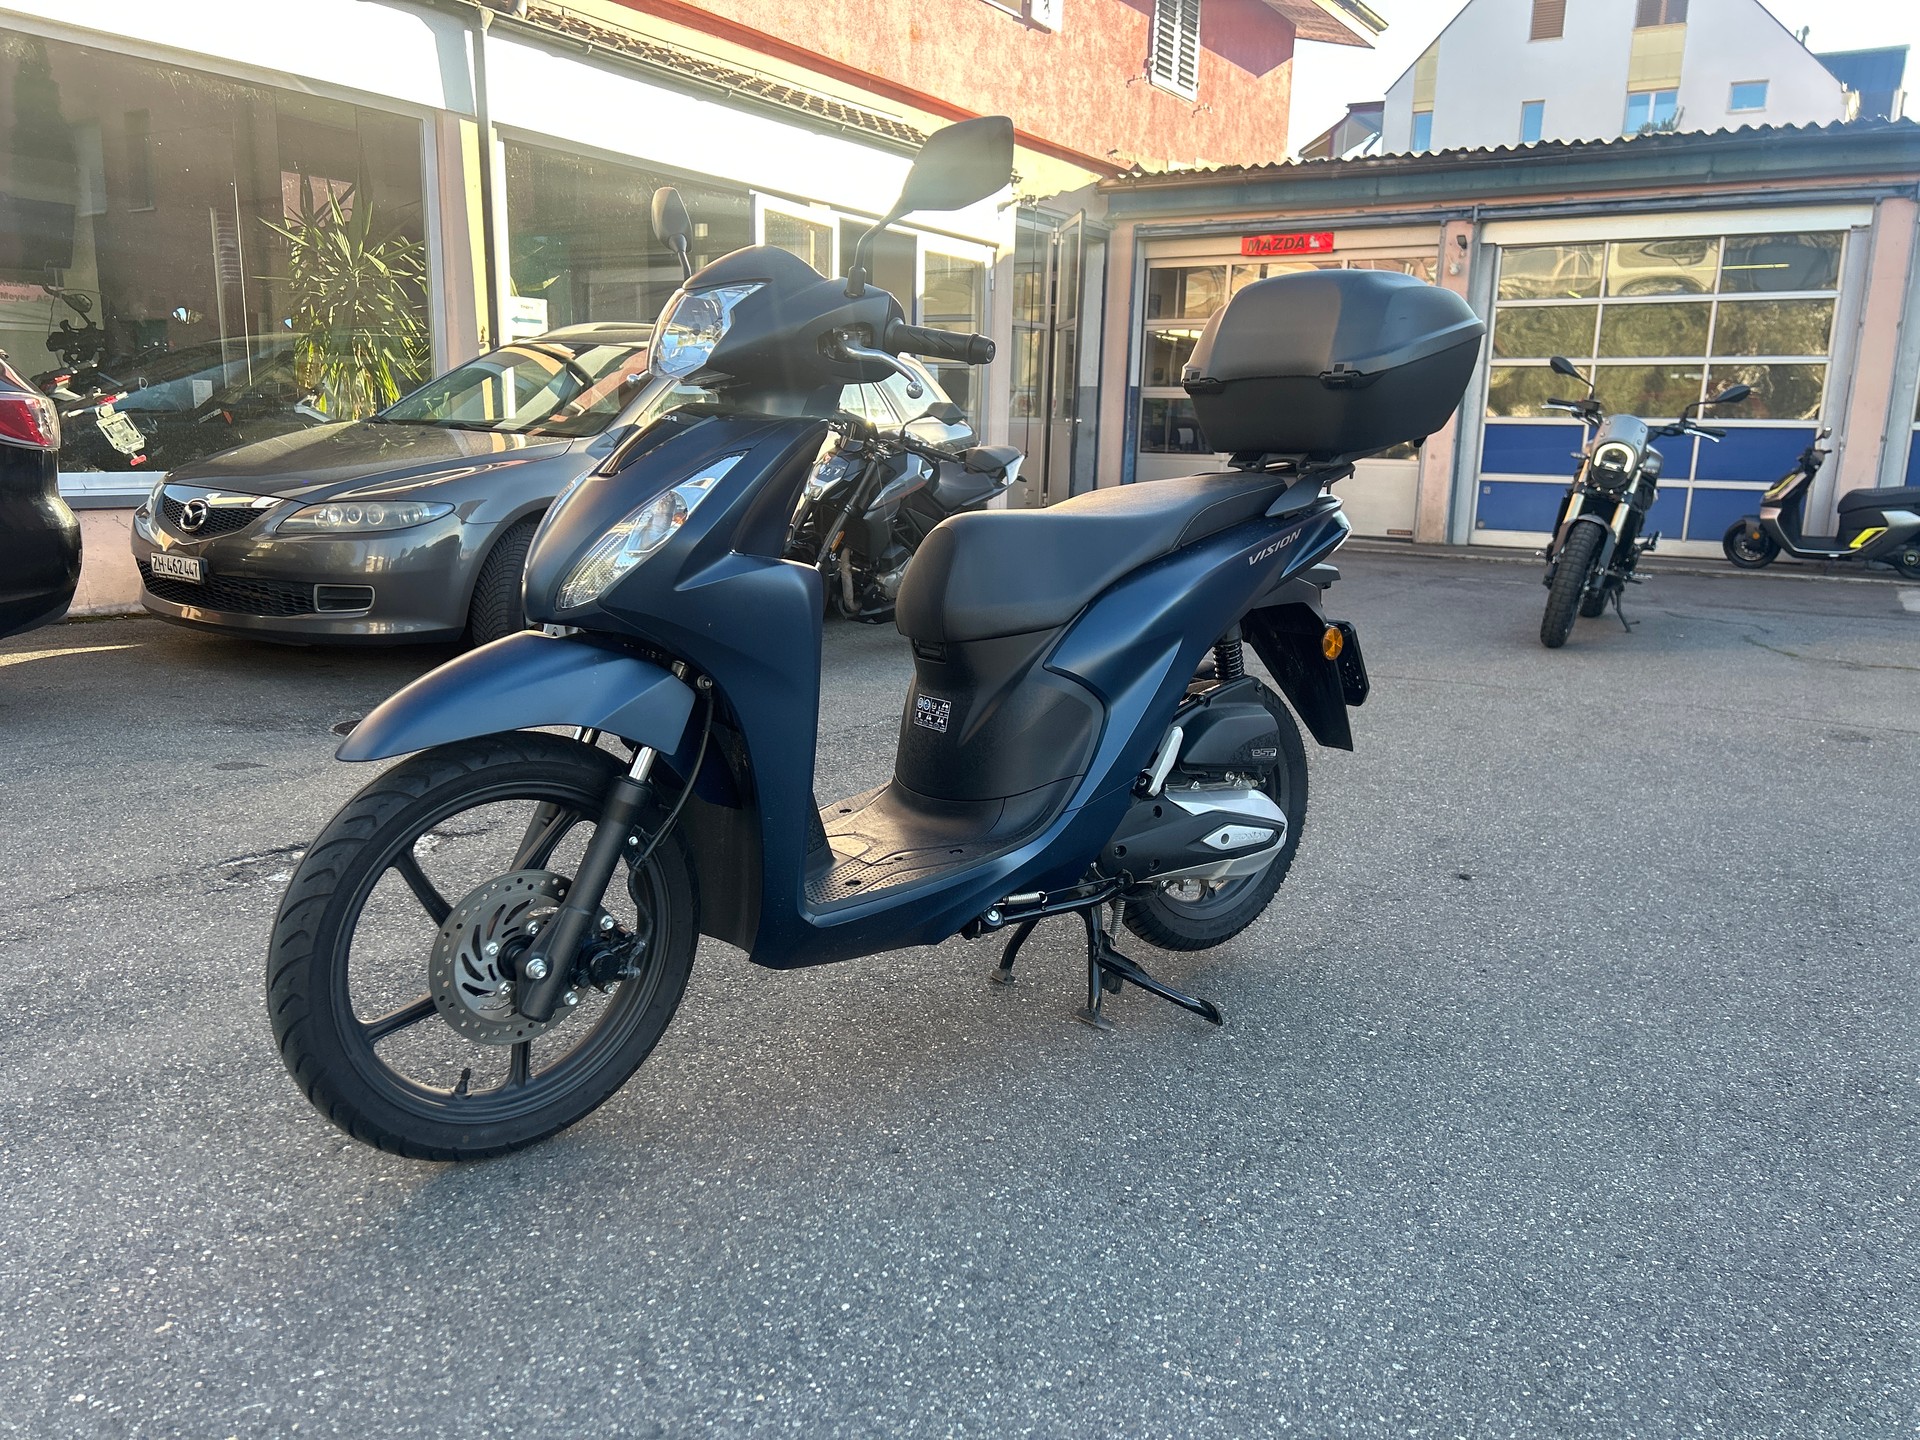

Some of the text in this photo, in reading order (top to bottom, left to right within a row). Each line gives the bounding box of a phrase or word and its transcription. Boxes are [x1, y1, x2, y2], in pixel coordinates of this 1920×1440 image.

[1247, 236, 1305, 252] MAZDA
[0, 291, 30, 302] Meyer
[1248, 527, 1302, 566] VISION
